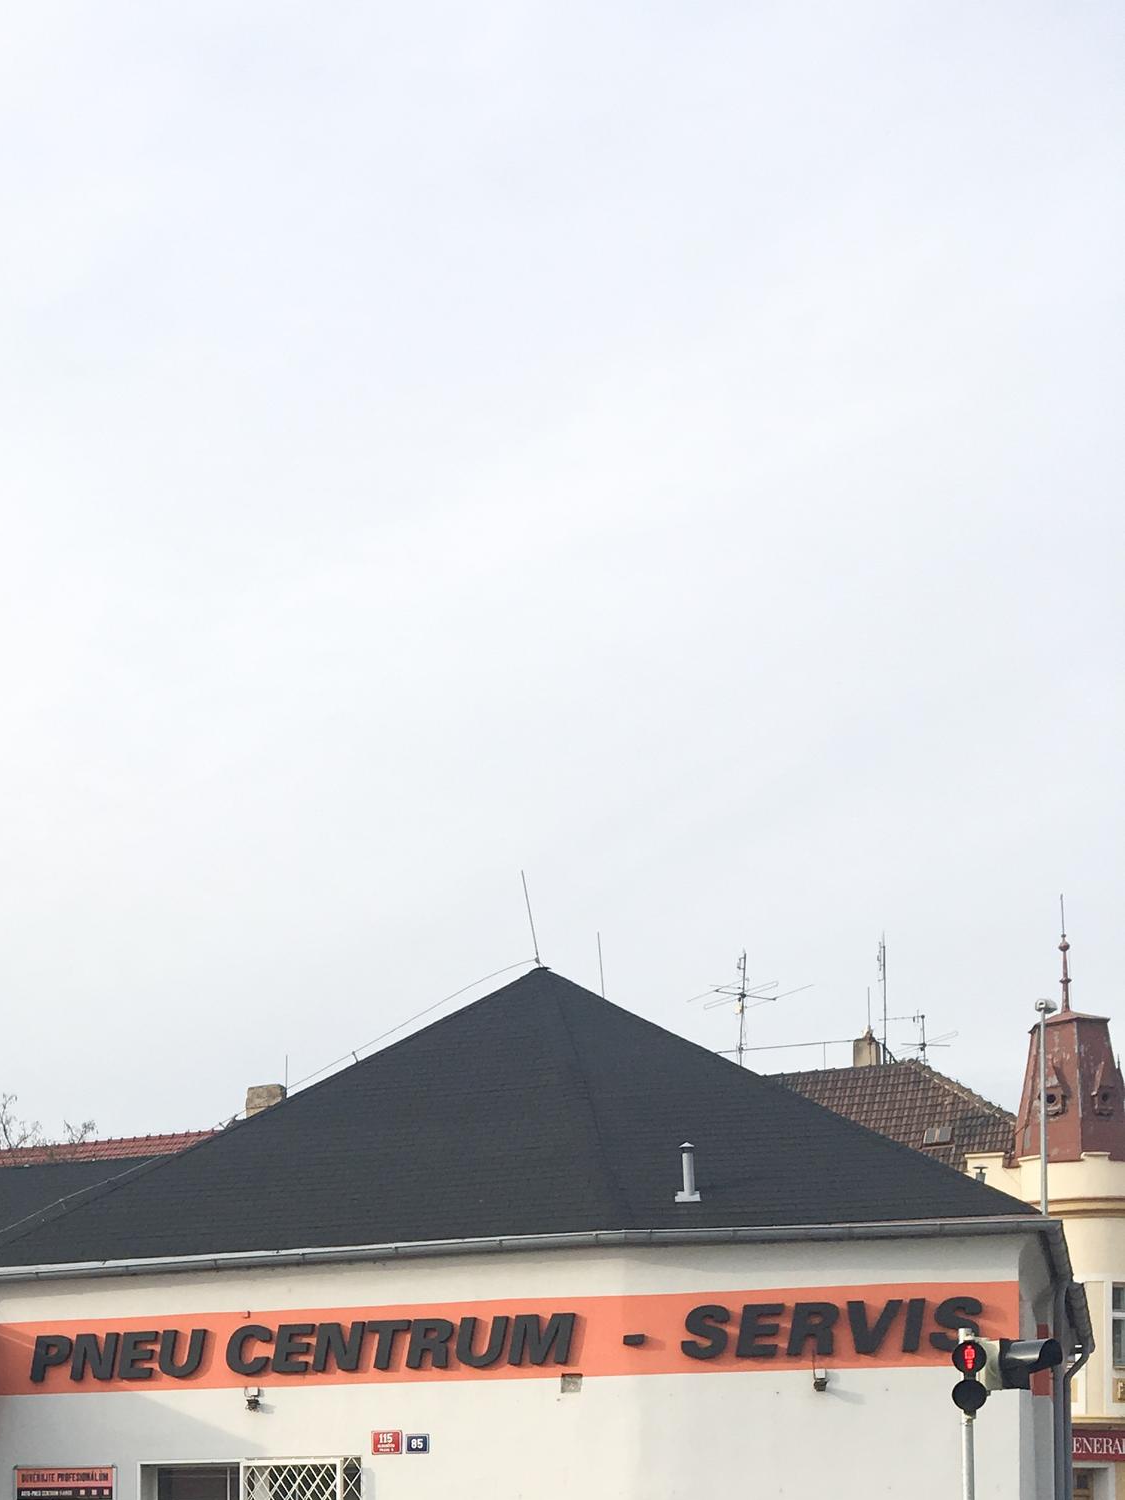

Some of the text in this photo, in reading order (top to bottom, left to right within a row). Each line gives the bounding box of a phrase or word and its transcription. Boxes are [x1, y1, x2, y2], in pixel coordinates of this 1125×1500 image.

[30, 1297, 983, 1383] PNEU CENTRUM - SERVIS
[379, 1433, 393, 1443] 115
[411, 1438, 423, 1449] 85
[1072, 1437, 1125, 1454] ENERA
